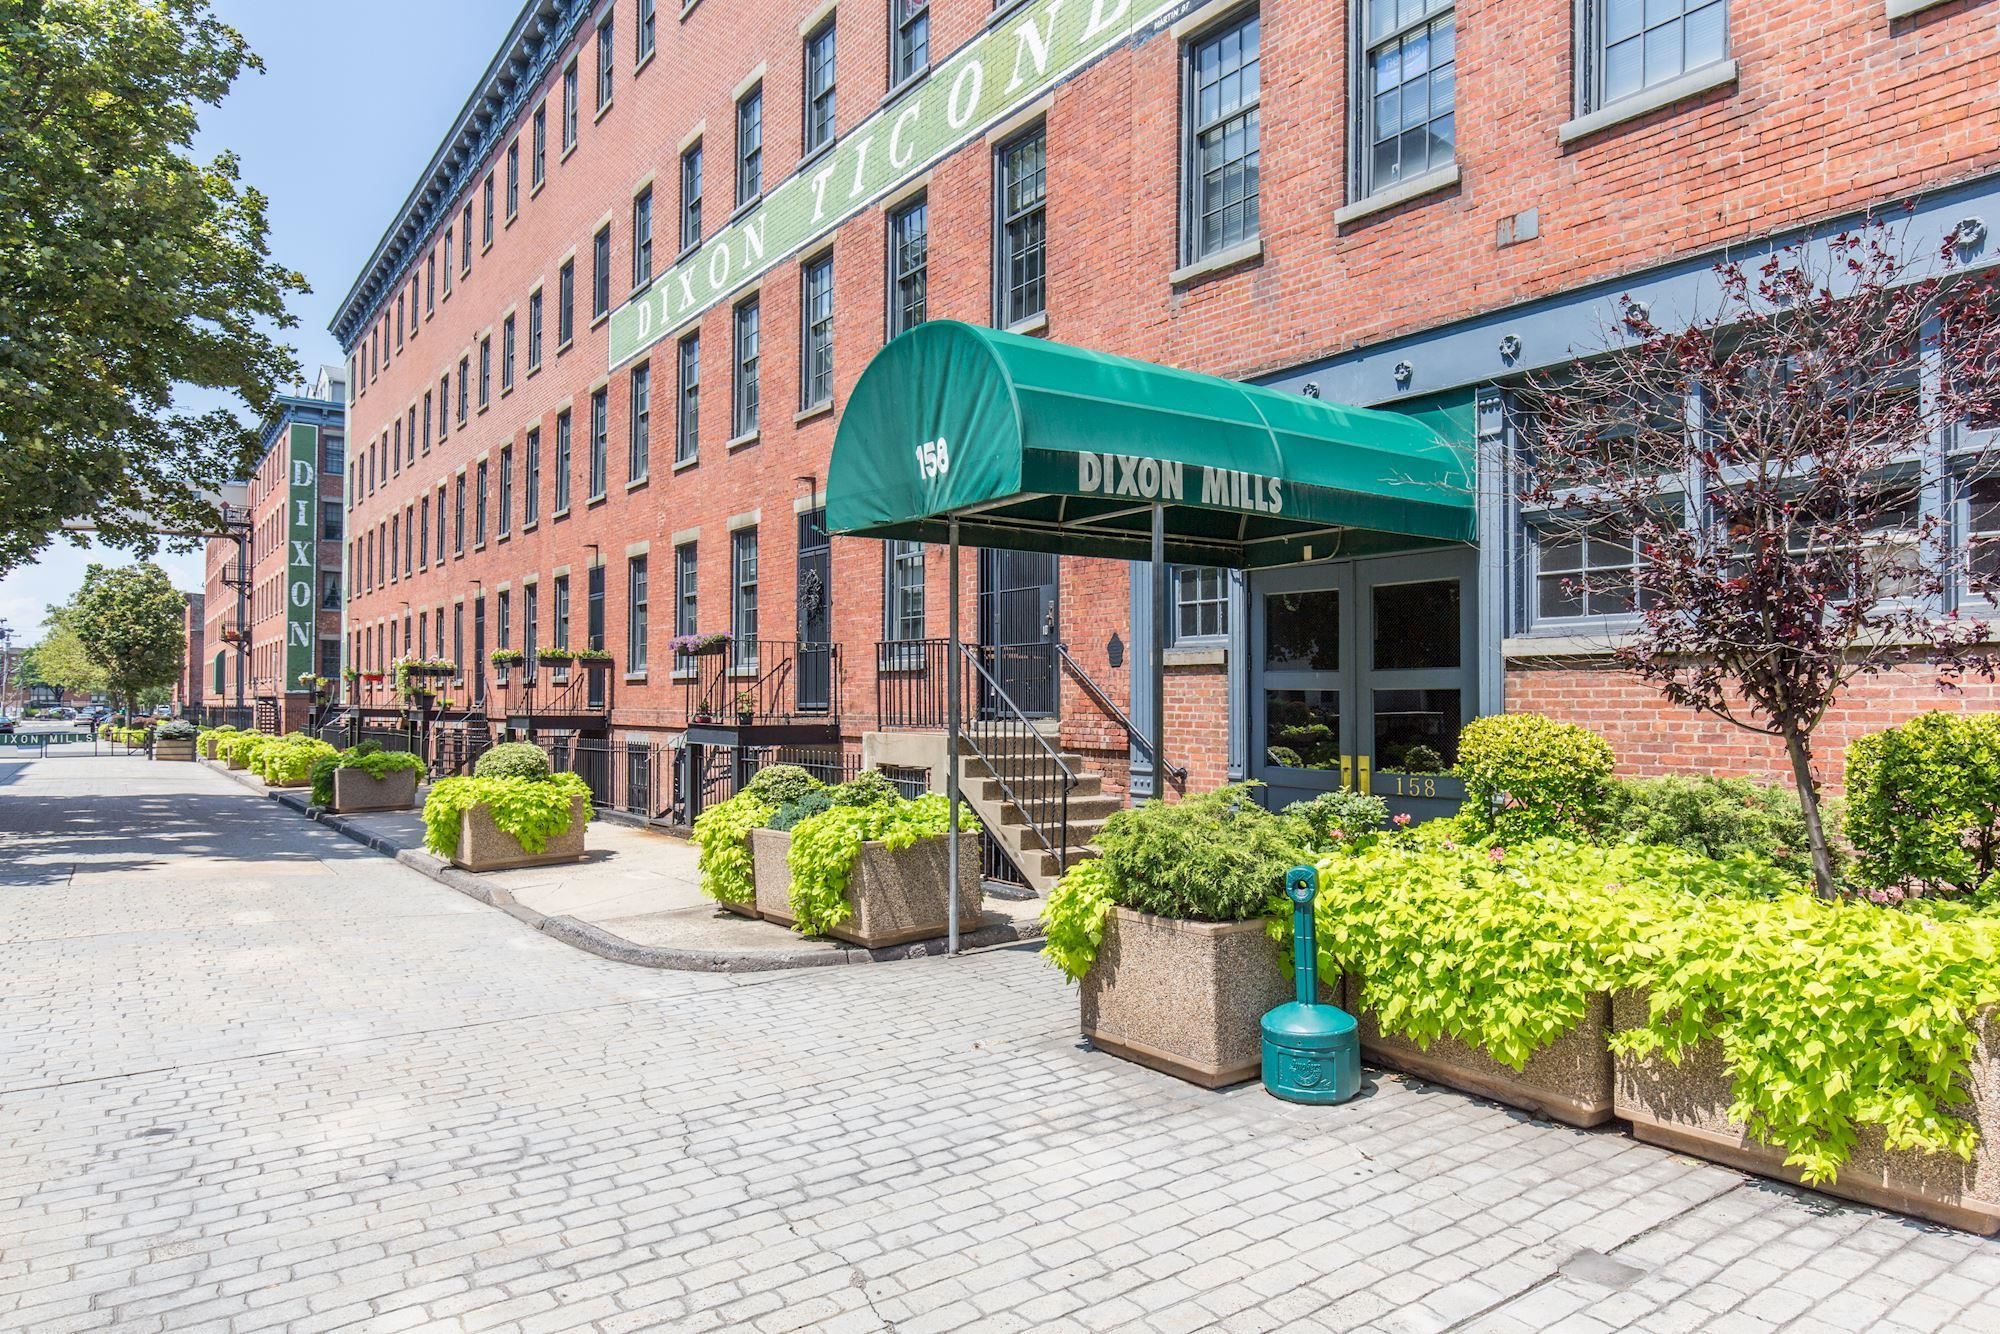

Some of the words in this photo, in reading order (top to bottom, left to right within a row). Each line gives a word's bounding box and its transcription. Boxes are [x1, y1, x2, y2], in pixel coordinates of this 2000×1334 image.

[637, 213, 768, 341] DIXON
[915, 436, 949, 480] 158
[1078, 450, 1184, 500] DIXON
[1201, 465, 1283, 514] MILLS
[288, 459, 314, 648] DIXON
[4, 734, 39, 744] IXON
[49, 733, 93, 743] MILLS
[1396, 777, 1436, 798] 158
